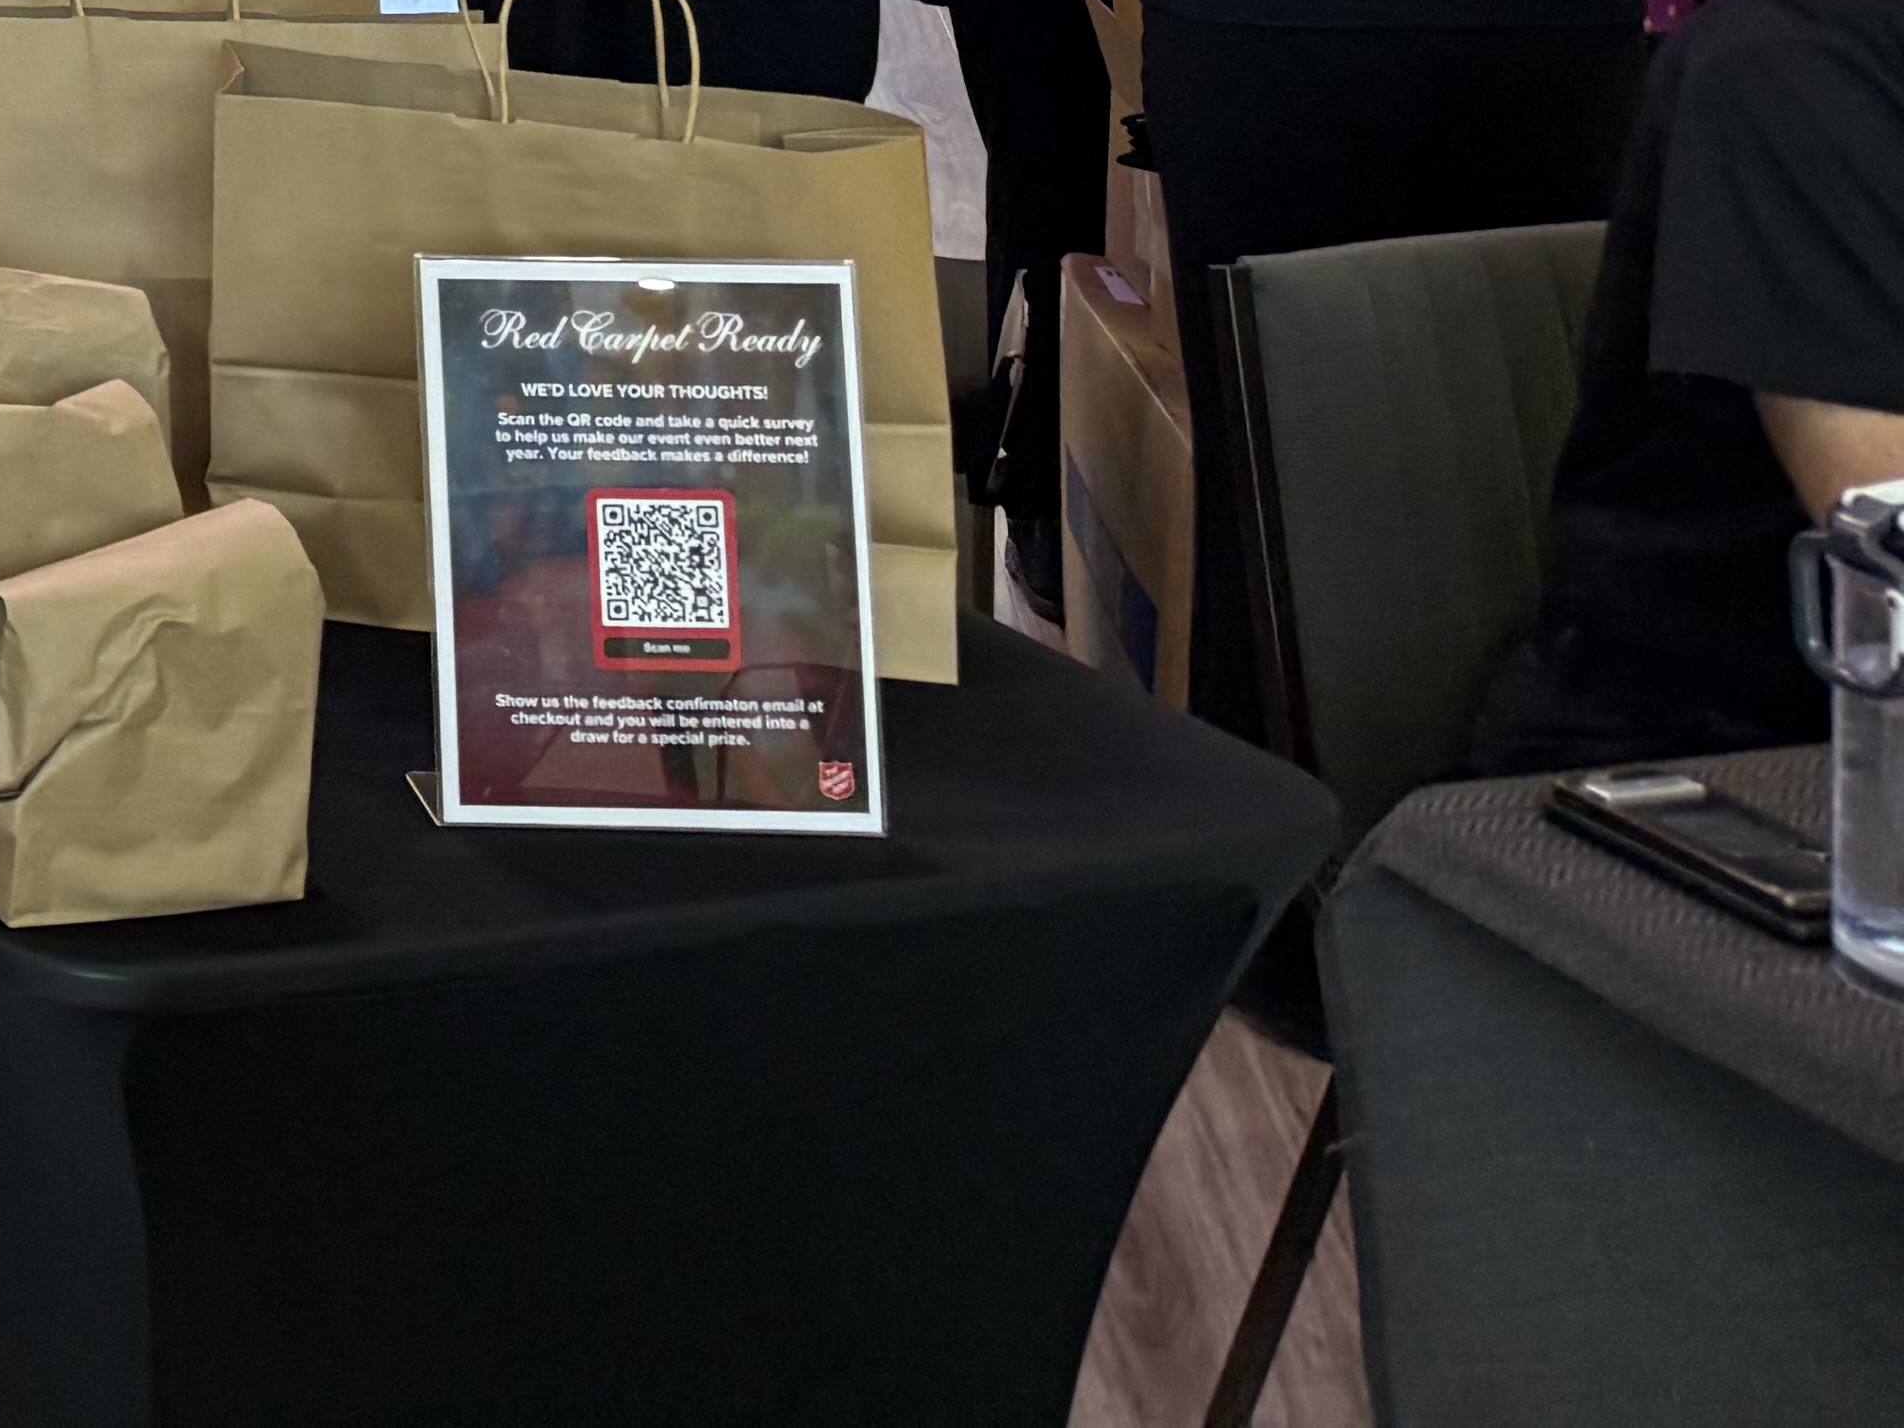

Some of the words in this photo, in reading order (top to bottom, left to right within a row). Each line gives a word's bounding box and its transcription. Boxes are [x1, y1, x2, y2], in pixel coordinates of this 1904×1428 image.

[479, 308, 568, 349] Red
[571, 309, 694, 364] Carpet
[696, 311, 822, 369] Ready
[521, 382, 565, 398] WE'D
[569, 383, 613, 398] LOVE
[616, 384, 665, 399] YOUR
[669, 385, 768, 400] THOUGHTS!
[498, 412, 535, 426] Scan
[538, 413, 564, 426] the
[567, 413, 591, 427] QR
[595, 414, 632, 428] code
[635, 415, 664, 428] and
[668, 414, 701, 428] take
[705, 417, 715, 429] a
[718, 415, 760, 431] quick
[763, 418, 815, 433] survey
[496, 430, 511, 442] to
[515, 430, 548, 446] help
[551, 432, 570, 444] us
[573, 431, 614, 444] make
[618, 433, 644, 445] our
[647, 433, 690, 445] event
[694, 434, 731, 446] even
[734, 433, 781, 447] better
[784, 434, 818, 447] next
[506, 448, 543, 462] year.
[547, 446, 584, 460] Your
[587, 447, 657, 462] feedback
[661, 449, 711, 462] makes
[714, 451, 724, 462] a
[727, 449, 810, 464] difference!
[495, 693, 538, 707] Show
[542, 696, 560, 708] us
[564, 695, 589, 709] the
[592, 696, 663, 710] feedback
[762, 698, 805, 712] email
[808, 700, 824, 713] at
[511, 712, 581, 726] checkout
[584, 713, 614, 726] and
[617, 715, 646, 729] you
[649, 714, 675, 727] will
[679, 714, 699, 728] be
[702, 715, 763, 729] entered
[765, 715, 796, 729] into
[799, 718, 810, 730] a
[570, 729, 609, 743] draw
[613, 730, 635, 744] for
[638, 733, 648, 744] a
[651, 731, 704, 747] special
[708, 731, 751, 748] prize.
